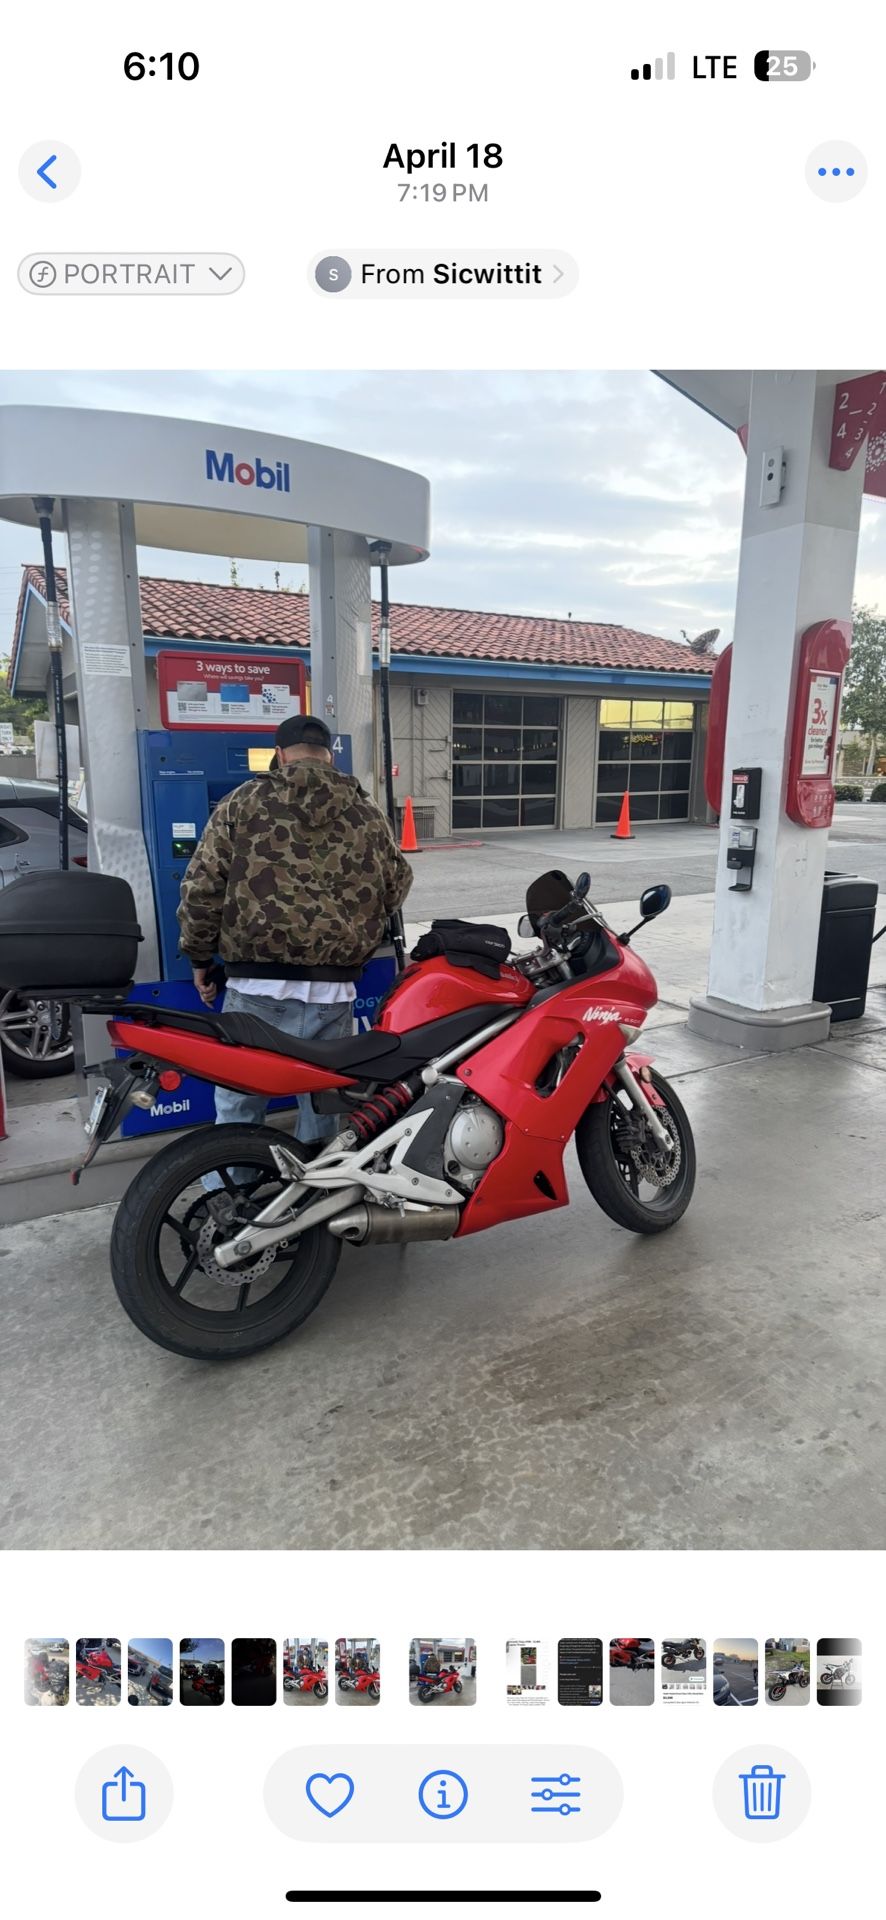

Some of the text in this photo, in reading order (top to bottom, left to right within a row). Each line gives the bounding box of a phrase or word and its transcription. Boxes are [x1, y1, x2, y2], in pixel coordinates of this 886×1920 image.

[839, 392, 849, 410] 2
[867, 402, 877, 415] 2
[836, 422, 847, 439] 4
[854, 427, 864, 440] 3
[205, 448, 290, 493] Mobil
[196, 660, 271, 675] 3 ways to save
[812, 698, 828, 725] 3x
[808, 725, 828, 736] cleaner
[332, 735, 344, 754] 4
[582, 1005, 622, 1026] Ninja
[150, 1099, 190, 1118] Mobil
